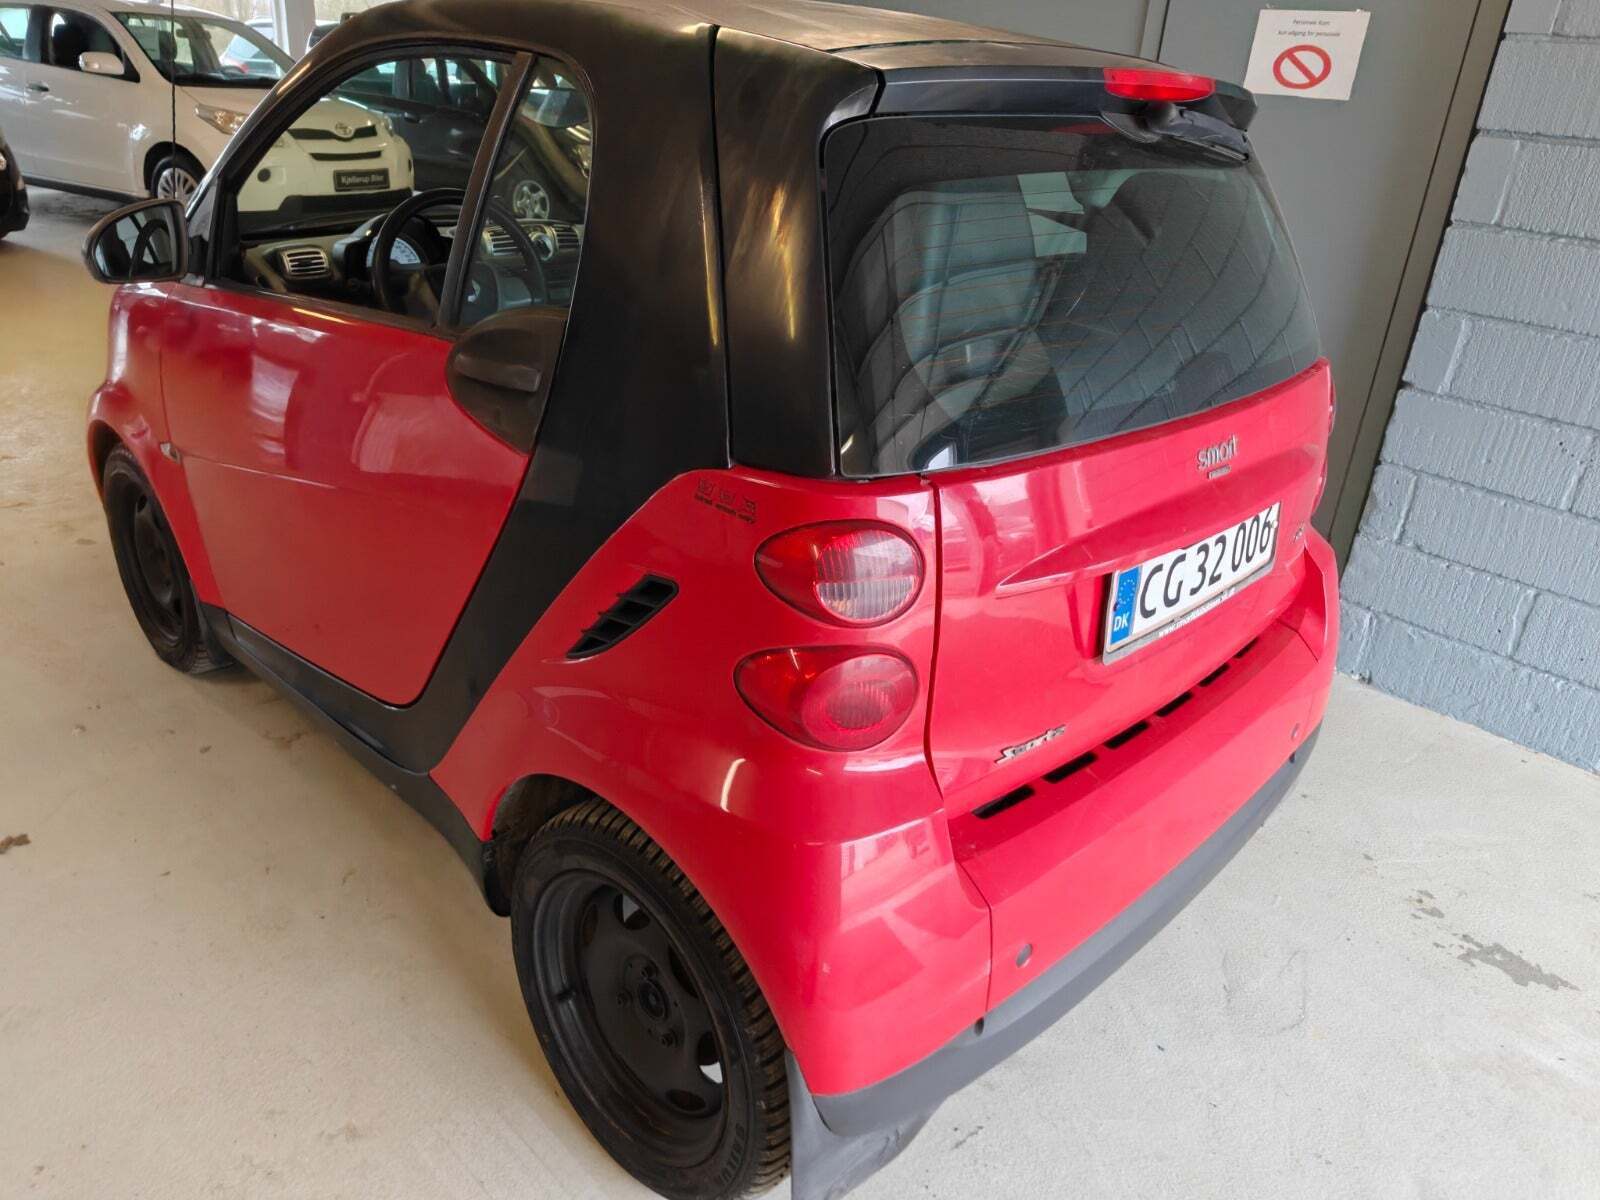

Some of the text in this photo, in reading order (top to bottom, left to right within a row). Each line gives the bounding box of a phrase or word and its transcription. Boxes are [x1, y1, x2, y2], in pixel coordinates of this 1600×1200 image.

[1139, 553, 1186, 619] CG
[1189, 534, 1227, 596] 32
[1231, 505, 1273, 573] 006
[1113, 611, 1128, 632] DK
